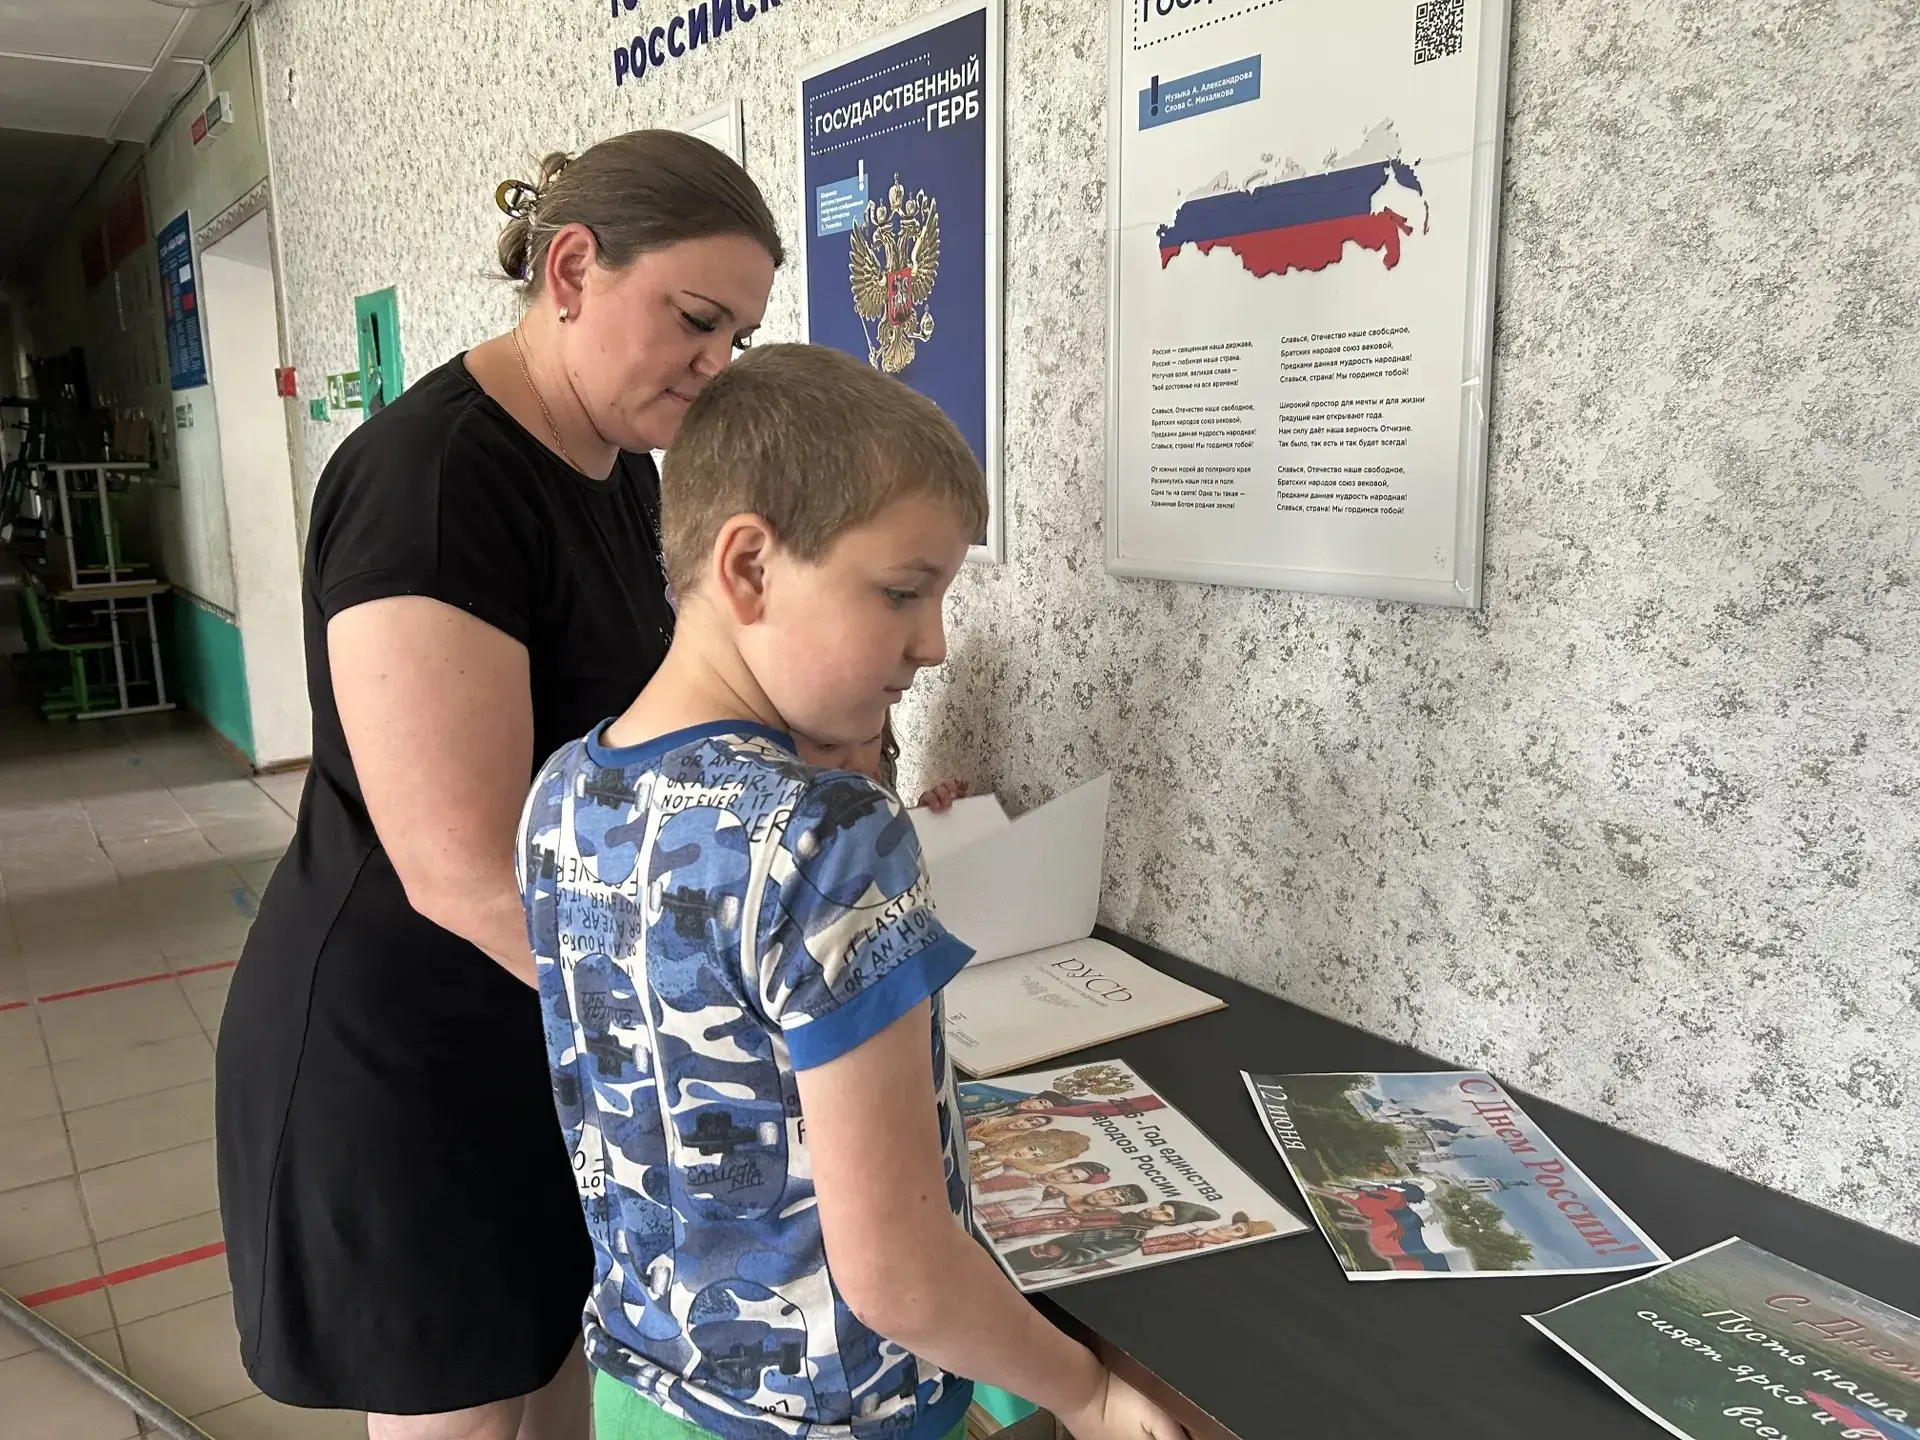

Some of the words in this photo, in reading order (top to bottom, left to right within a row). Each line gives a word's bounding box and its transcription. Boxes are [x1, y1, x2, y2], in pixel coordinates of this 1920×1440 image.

[614, 0, 781, 86] РОССИЙС
[815, 54, 979, 136] ГОСУДАРСТВЕННЫЙ
[1165, 89, 1190, 102] Музыка
[1192, 86, 1199, 95] А.
[1201, 71, 1252, 92] Александрова
[1165, 101, 1185, 113] Слова
[1187, 99, 1193, 107] С.
[1196, 88, 1234, 105] Михалкова
[926, 90, 979, 132] ГЕРБ
[1281, 336, 1309, 344] Славься,
[1311, 333, 1346, 342] Отечество
[1368, 326, 1410, 336] свободное,
[1281, 349, 1310, 358] Братских
[1312, 347, 1341, 355] народов
[1362, 341, 1393, 350] вековой,
[1281, 362, 1312, 370] Предками
[1314, 360, 1338, 368] данная
[1340, 358, 1372, 366] мудрость
[1374, 354, 1412, 363] народная!
[1310, 373, 1334, 381] страна!
[1336, 372, 1347, 380] Мы
[1349, 370, 1382, 379] гордимся
[1385, 368, 1409, 376] тобой!
[1280, 401, 1310, 410] Широкий
[1279, 414, 1310, 422] Грядущие
[1326, 413, 1364, 421] открывают
[1346, 426, 1378, 434] верность
[1290, 440, 1309, 448] было,
[1359, 439, 1379, 447] будет
[1381, 438, 1407, 446] всегда!
[1364, 466, 1405, 474] свободное,
[1358, 480, 1389, 488] вековой,
[1277, 491, 1309, 499] Предками
[1277, 504, 1304, 512] Славься,
[1345, 506, 1378, 514] гордимся
[667, 772, 686, 790] OR
[661, 795, 693, 809] NOT
[845, 968, 868, 992] OR
[872, 939, 894, 970] AN
[1256, 1082, 1288, 1100] 12
[1458, 1078, 1497, 1095] С
[1266, 1103, 1307, 1150] июня
[1461, 1099, 1538, 1155] Днем
[1138, 1125, 1167, 1148] Год
[1160, 1147, 1223, 1202] единства
[1131, 1154, 1182, 1198] России
[1520, 1158, 1641, 1255] России!
[1764, 1294, 1811, 1312] С
[1636, 1310, 1723, 1362] сияет
[1728, 1364, 1808, 1405] ярко
[1811, 1410, 1837, 1425] и
[1701, 1309, 1806, 1366] Пусть
[1812, 1368, 1908, 1422] наша
